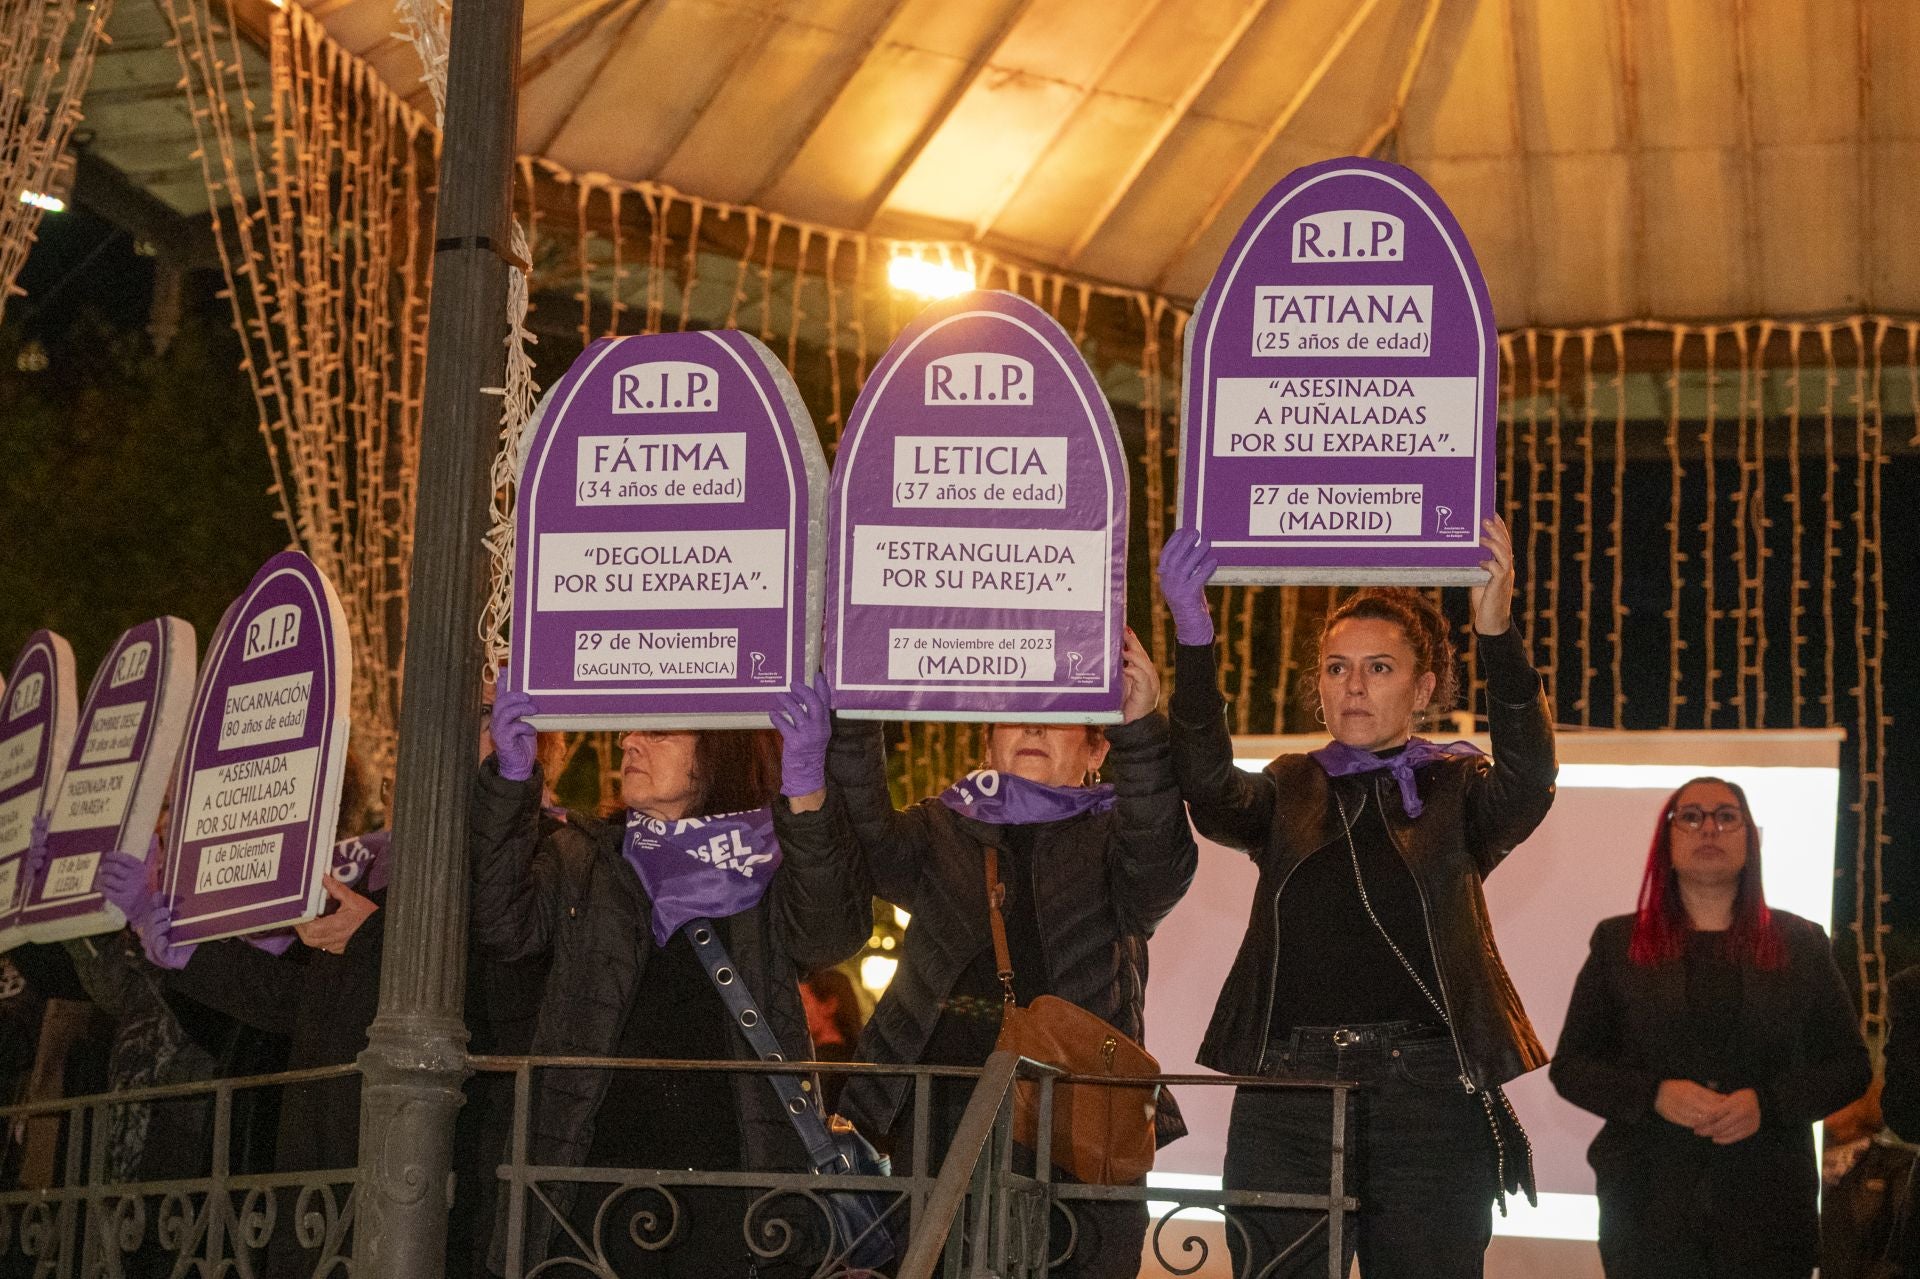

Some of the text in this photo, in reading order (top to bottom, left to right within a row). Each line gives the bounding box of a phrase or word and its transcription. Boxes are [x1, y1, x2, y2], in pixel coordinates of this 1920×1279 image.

[1298, 221, 1398, 258] R.I.P.
[1262, 295, 1424, 324] TATIANA
[1256, 332, 1430, 352] (25 años de edad)
[618, 372, 712, 409] R.I.P.
[931, 364, 1027, 401] R.I.P.
[1268, 379, 1415, 398] “ASESINADA
[1254, 402, 1427, 425] A PUÑALADAS
[593, 437, 730, 473] FÁTIMA
[1230, 433, 1456, 456] POR SU EXPAREJA”.
[914, 446, 1048, 476] LETICIA
[578, 477, 743, 502] (34 años de edad)
[895, 482, 1064, 504] (37 años de edad)
[1253, 487, 1422, 505] 27 de Noviembre
[1279, 510, 1393, 534] (MADRID)
[584, 546, 733, 566] “DEGOLLADA
[876, 541, 1075, 565] “ESTRANGULADA
[554, 571, 768, 595] POR SU EXPAREJA”.
[882, 568, 1073, 595] POR SU PAREJA”.
[247, 612, 297, 656] R.I.P.
[577, 631, 737, 651] 29 de Noviembre
[893, 637, 1053, 651] 27 de Noviembre del 2023
[114, 649, 147, 684] R.I.P.
[576, 662, 654, 678] (SAGUNTO,
[659, 661, 736, 679] VALENCIA)
[917, 655, 1028, 679] (MADRID)
[225, 682, 310, 715] ENCARNACIÓN
[221, 708, 306, 741] (80 años de edad)
[218, 756, 288, 784] “ASESINADA
[203, 777, 297, 811] A CUCHILLADAS
[197, 802, 298, 837] POR SU MARIDO”.
[206, 839, 276, 865] 1 de Diciembre
[200, 858, 273, 890] (A CORUÑA)
